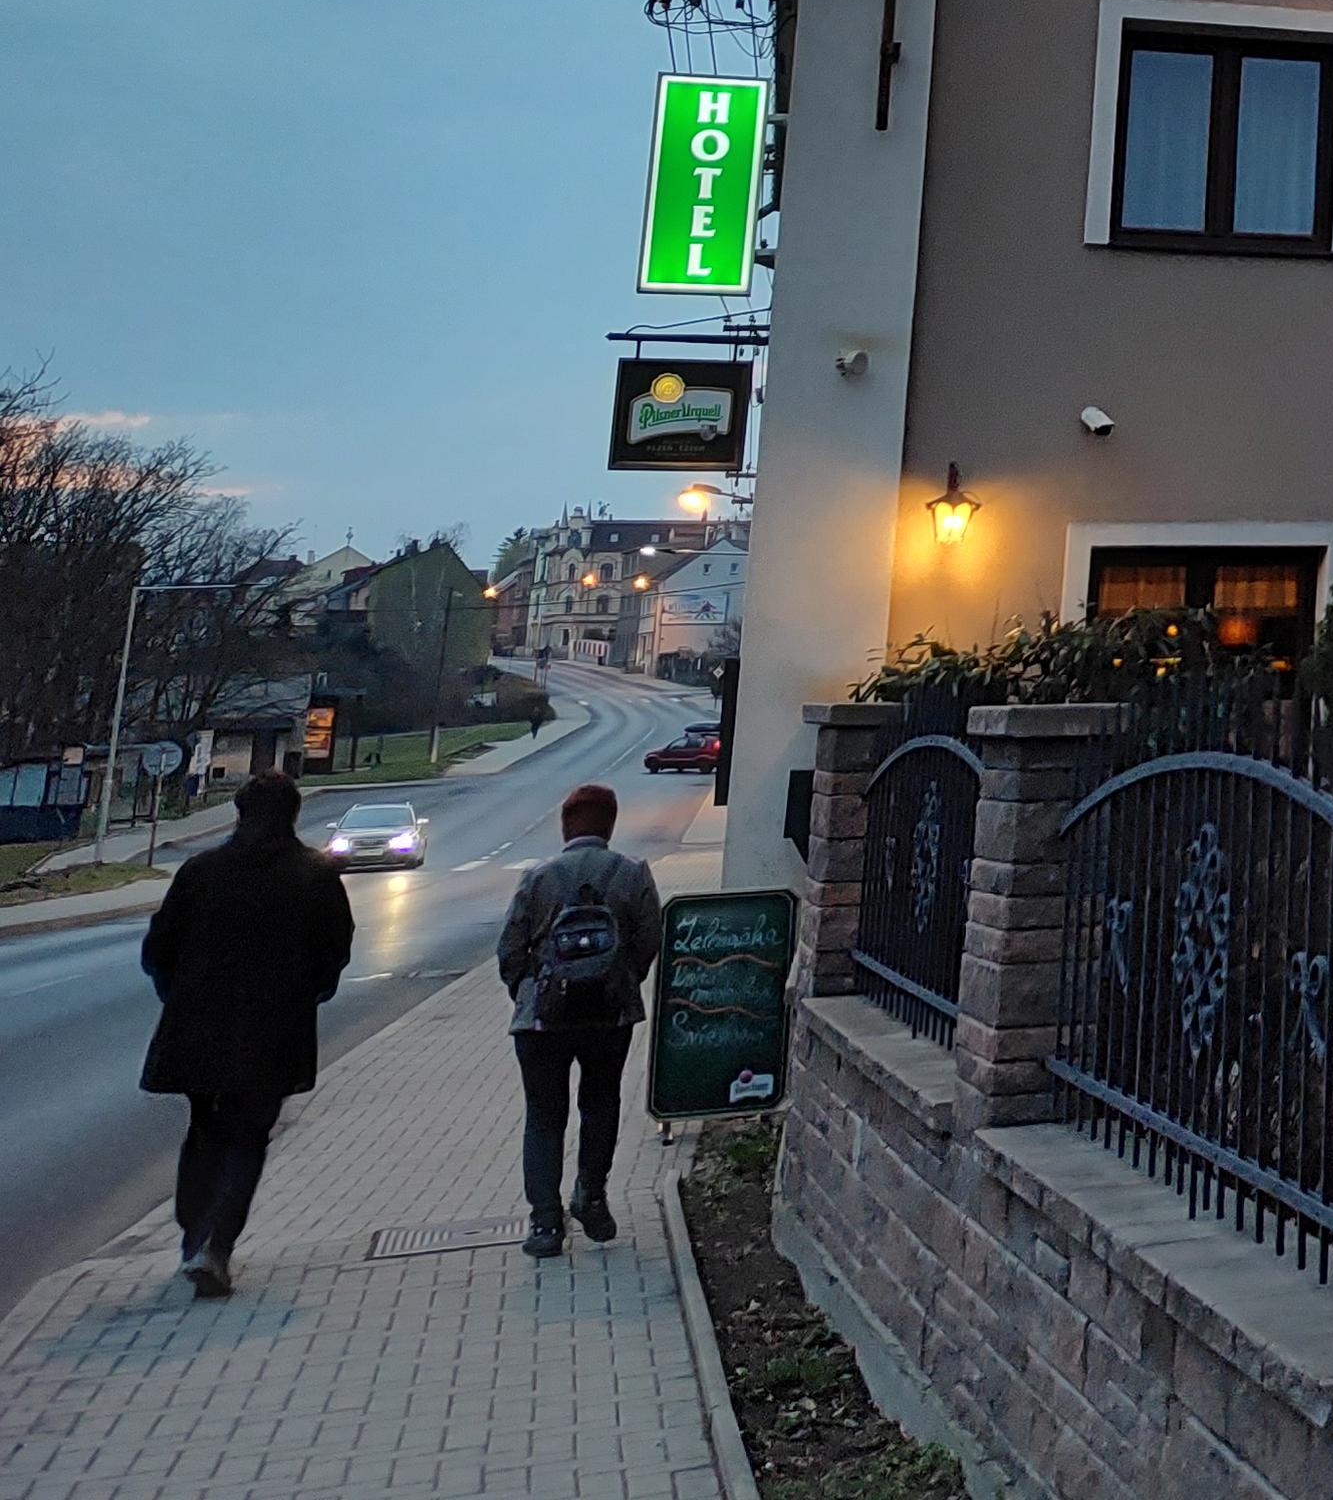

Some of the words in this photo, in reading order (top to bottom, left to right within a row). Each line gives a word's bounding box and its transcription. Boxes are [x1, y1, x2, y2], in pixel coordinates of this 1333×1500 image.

[685, 91, 731, 277] HOTEL
[639, 403, 682, 430] Pilsner
[681, 402, 722, 422] Urquell
